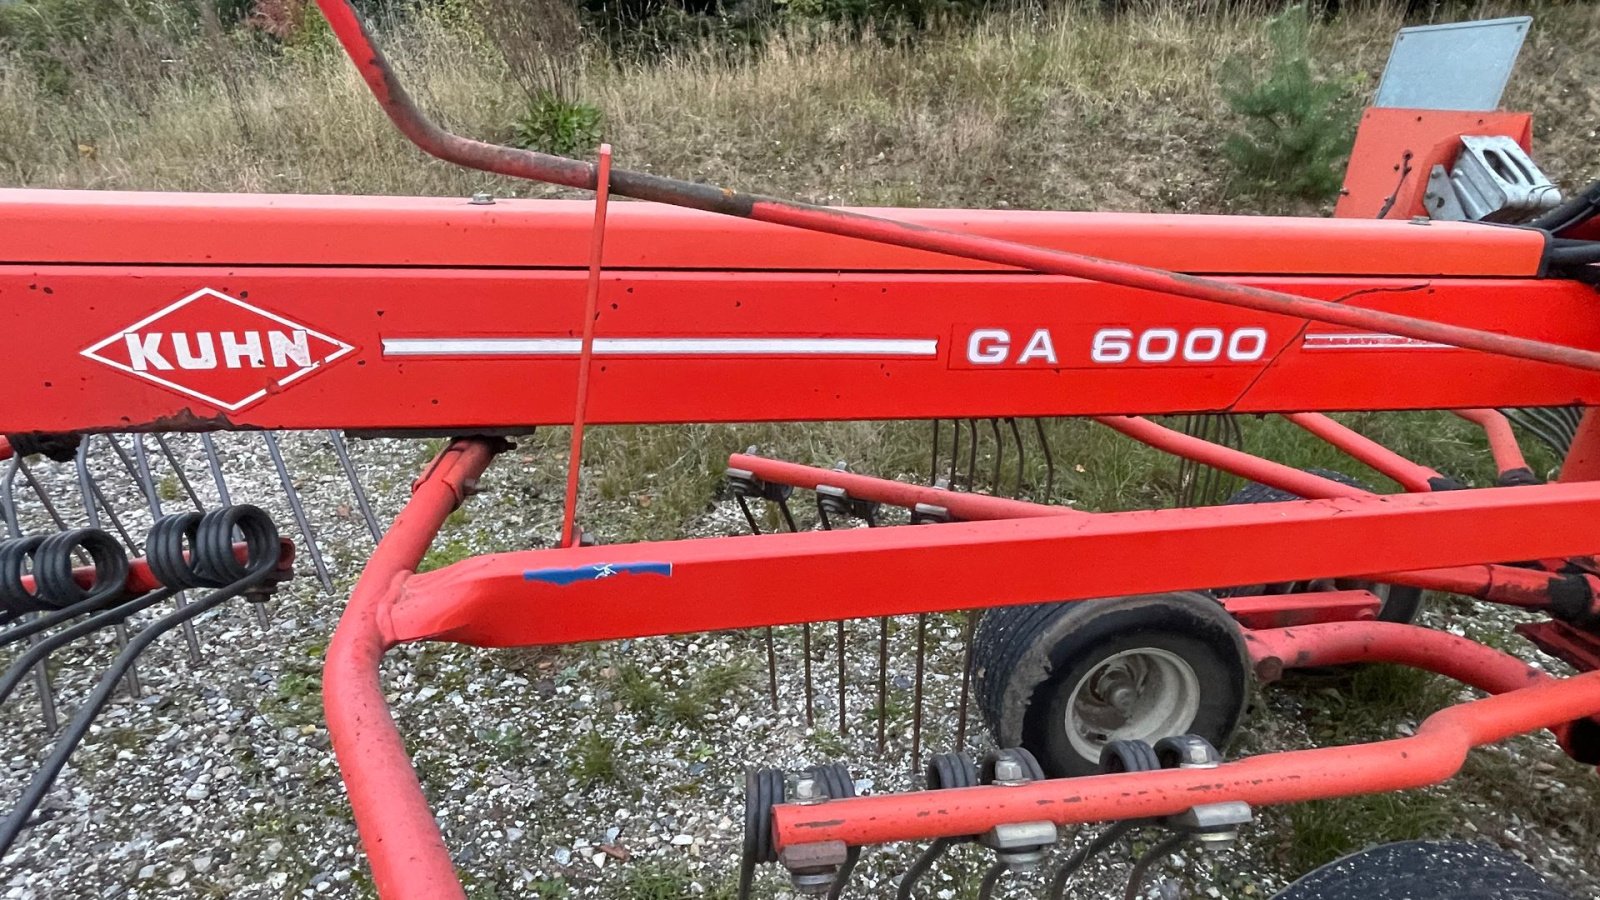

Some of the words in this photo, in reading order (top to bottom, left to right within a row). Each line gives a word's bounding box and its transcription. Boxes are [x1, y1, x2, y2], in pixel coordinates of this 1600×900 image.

[124, 329, 313, 371] KUHN
[967, 328, 1058, 364] GA
[1091, 327, 1268, 363] 6000
